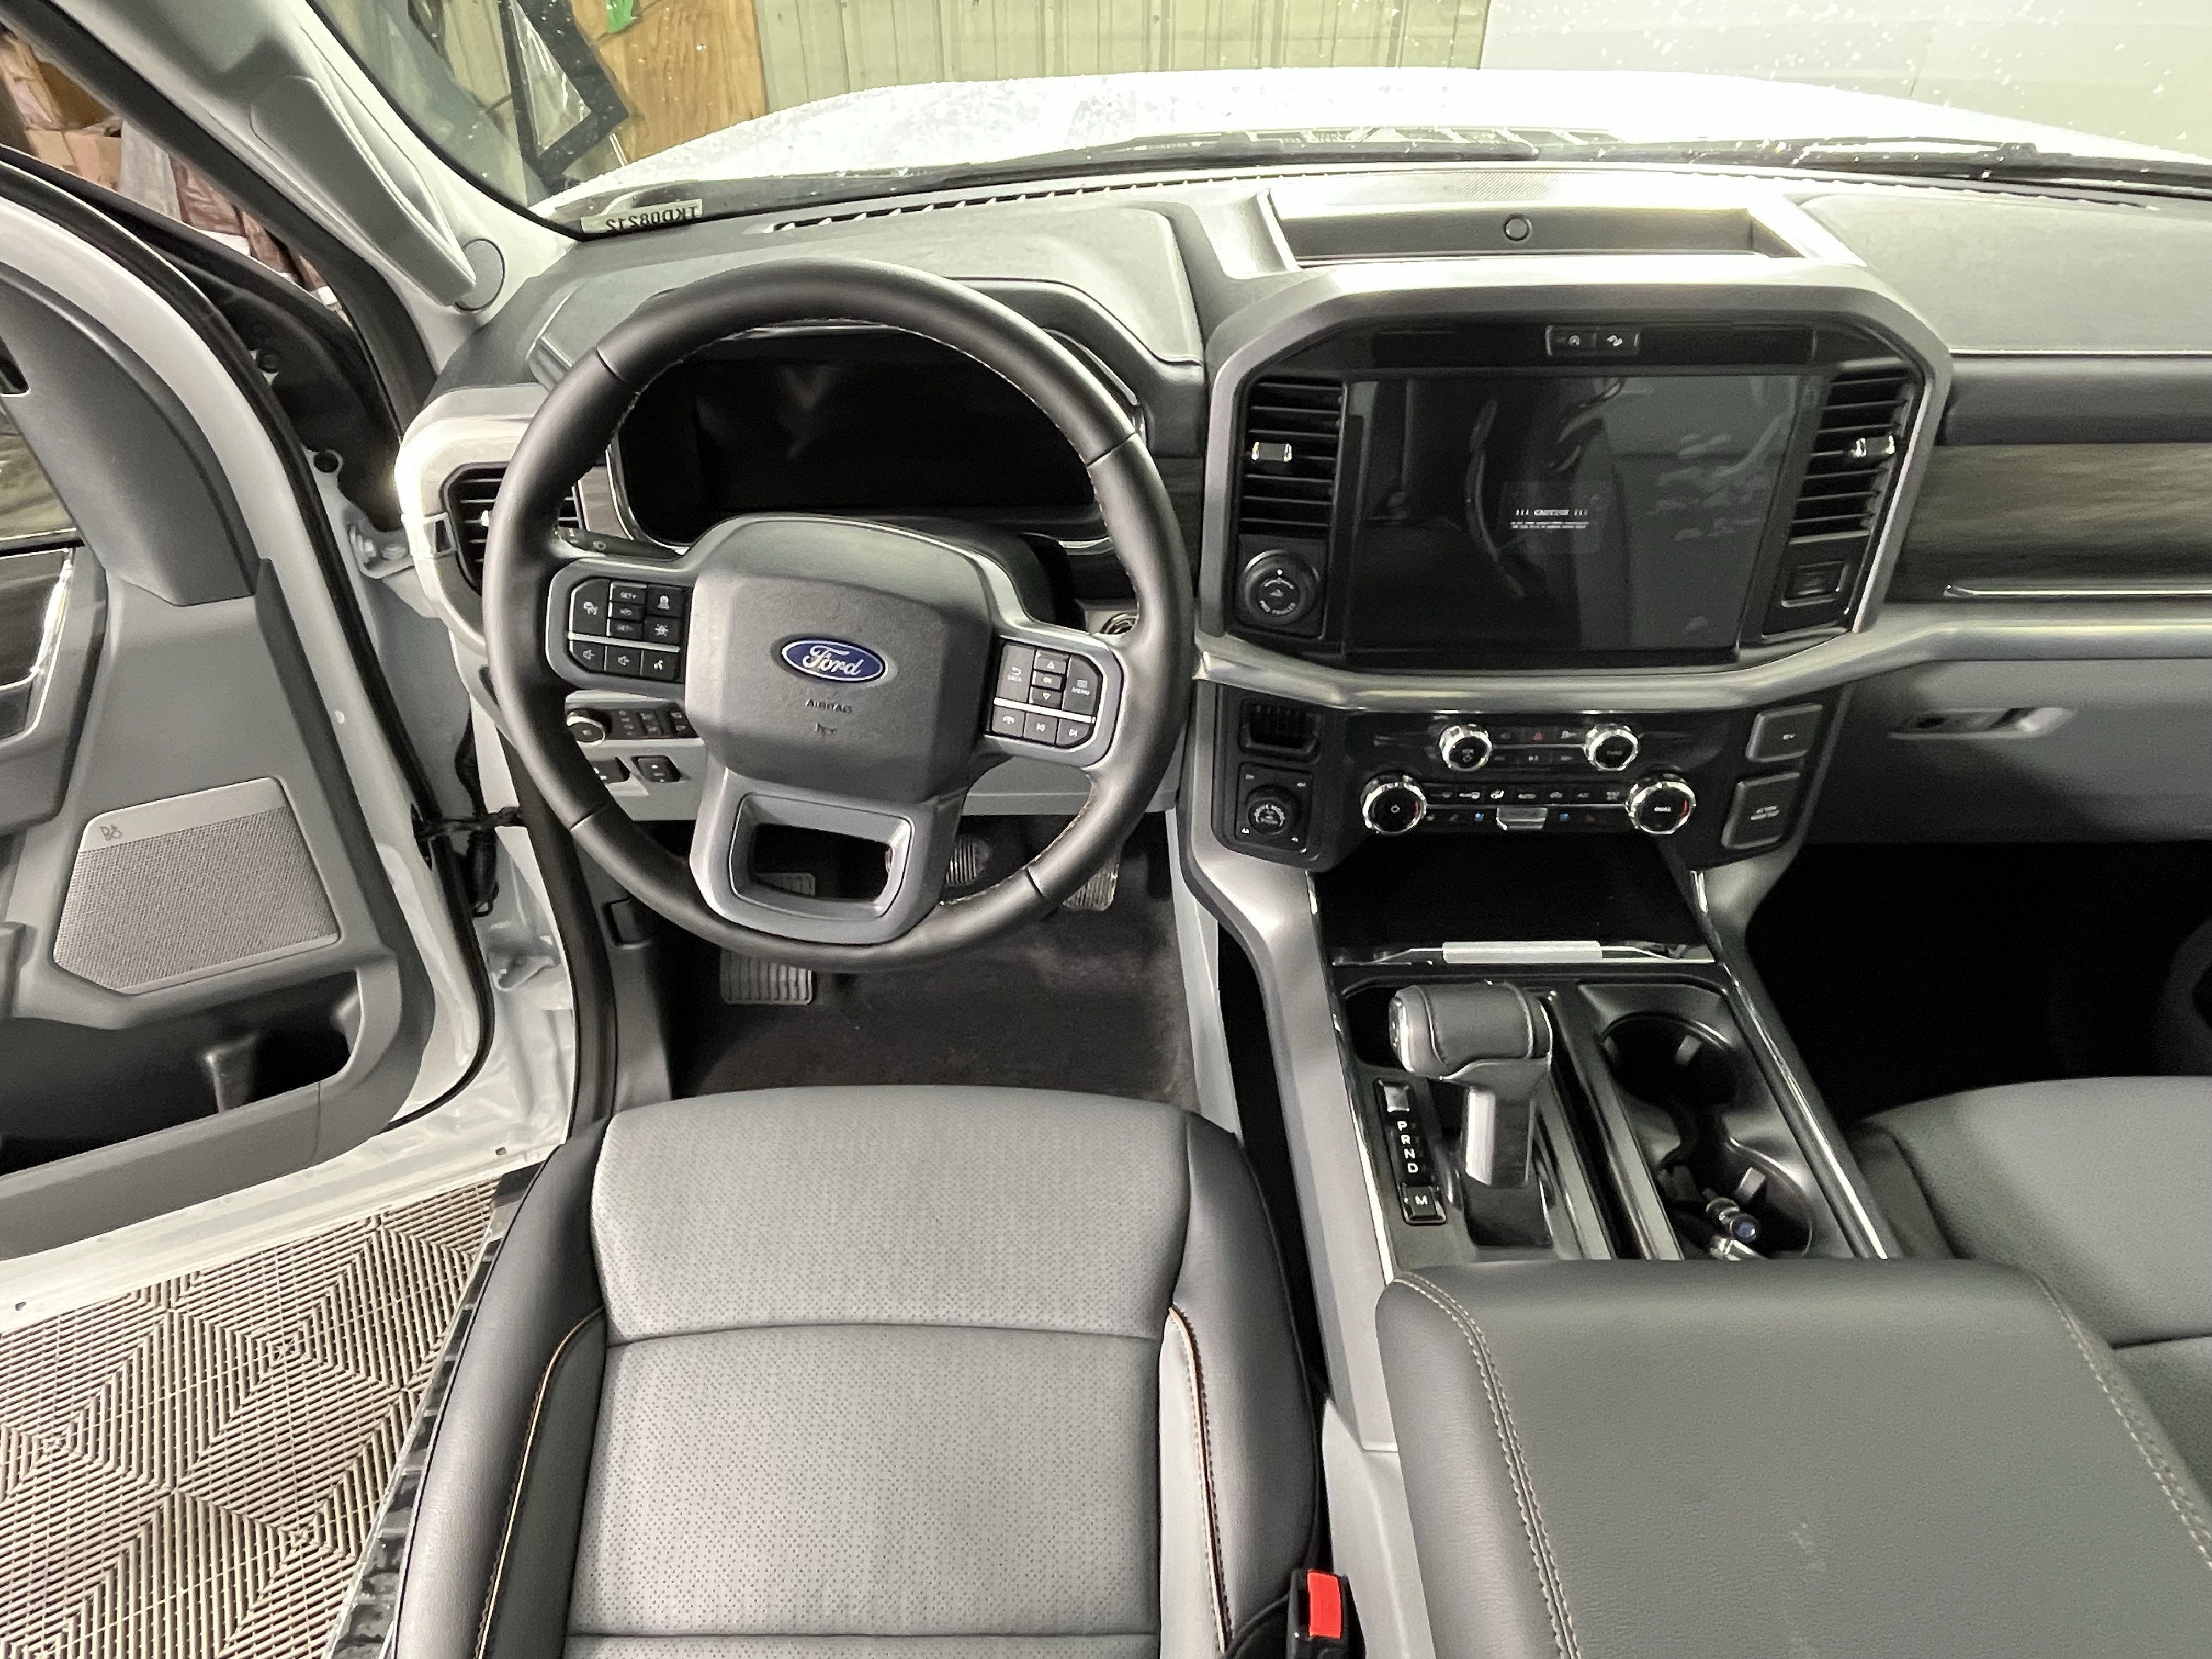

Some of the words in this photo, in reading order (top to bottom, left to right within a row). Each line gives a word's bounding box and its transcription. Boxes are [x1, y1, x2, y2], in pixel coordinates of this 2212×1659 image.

[802, 645, 864, 676] Ford
[1397, 1120, 1408, 1131] P
[1401, 1134, 1411, 1145] R
[1403, 1148, 1415, 1159] N
[1407, 1163, 1419, 1173] D
[1415, 1195, 1429, 1205] M
